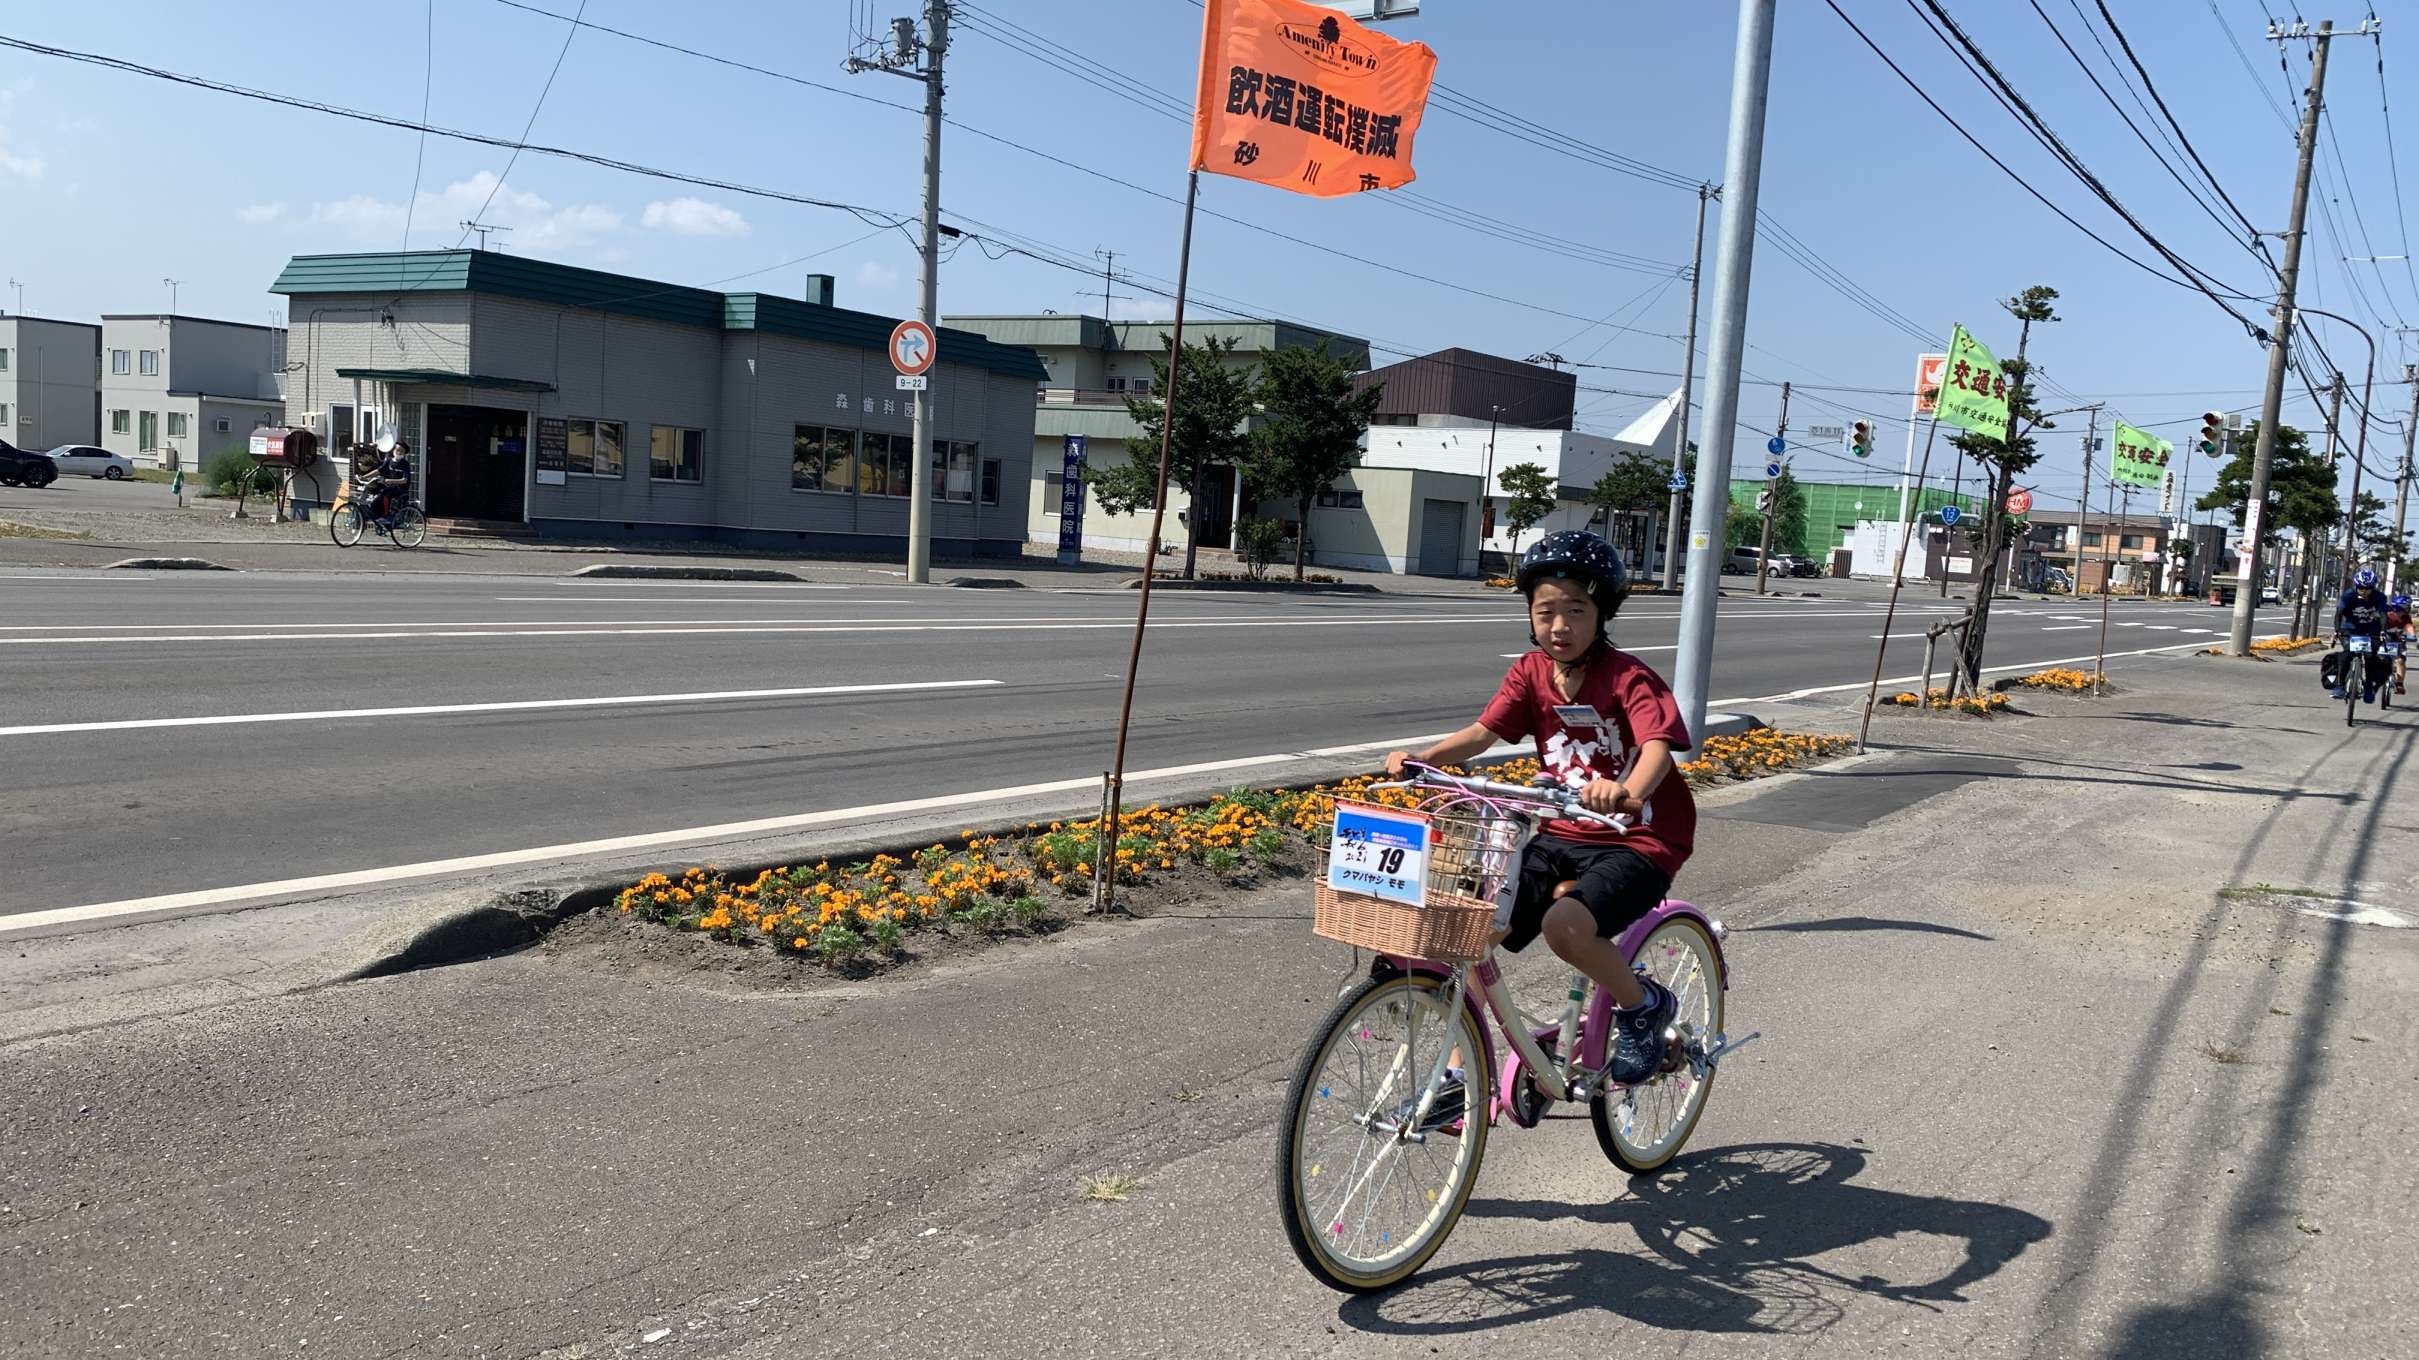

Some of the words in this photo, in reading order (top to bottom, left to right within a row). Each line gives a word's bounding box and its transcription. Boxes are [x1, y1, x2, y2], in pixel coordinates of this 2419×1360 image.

[1279, 25, 1336, 59] Amenity
[1340, 46, 1377, 70] Town
[1225, 65, 1402, 160] 飲酒運転撲滅
[1234, 140, 1381, 193] 砂川市
[900, 378, 922, 388] 9-22
[835, 393, 934, 421] 森歯科医
[1061, 442, 1080, 535] 森歯科医院
[1377, 847, 1406, 875] 19
[1389, 878, 1406, 889] モモ
